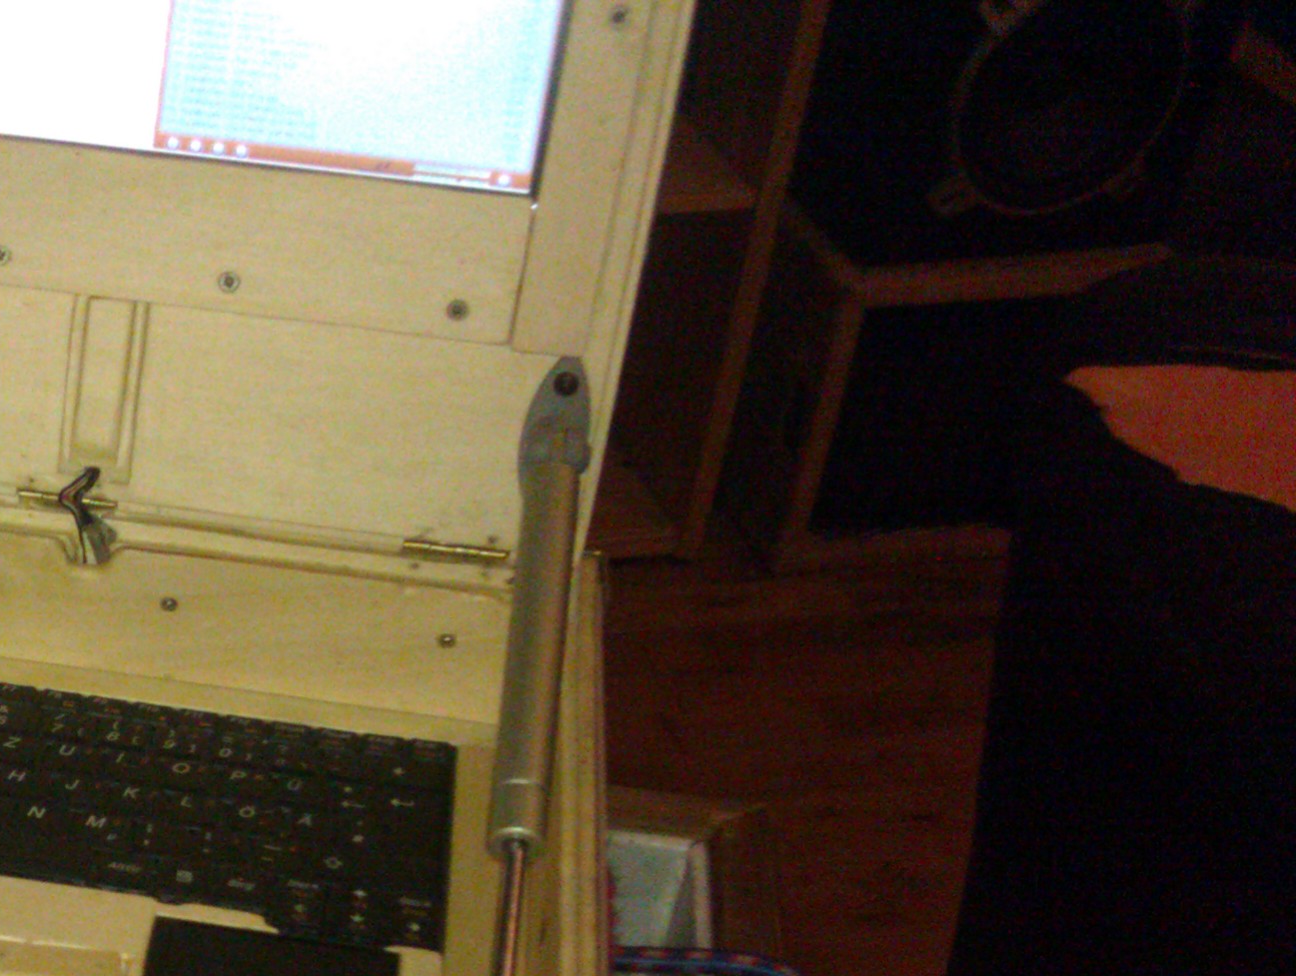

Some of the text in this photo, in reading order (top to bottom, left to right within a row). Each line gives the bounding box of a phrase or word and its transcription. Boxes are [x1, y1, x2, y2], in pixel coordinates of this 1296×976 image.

[2, 735, 22, 749] Z
[58, 743, 78, 757] U
[6, 769, 27, 783] H
[64, 778, 81, 791] J
[122, 785, 141, 800] K
[26, 804, 47, 820] N
[84, 814, 108, 829] M
